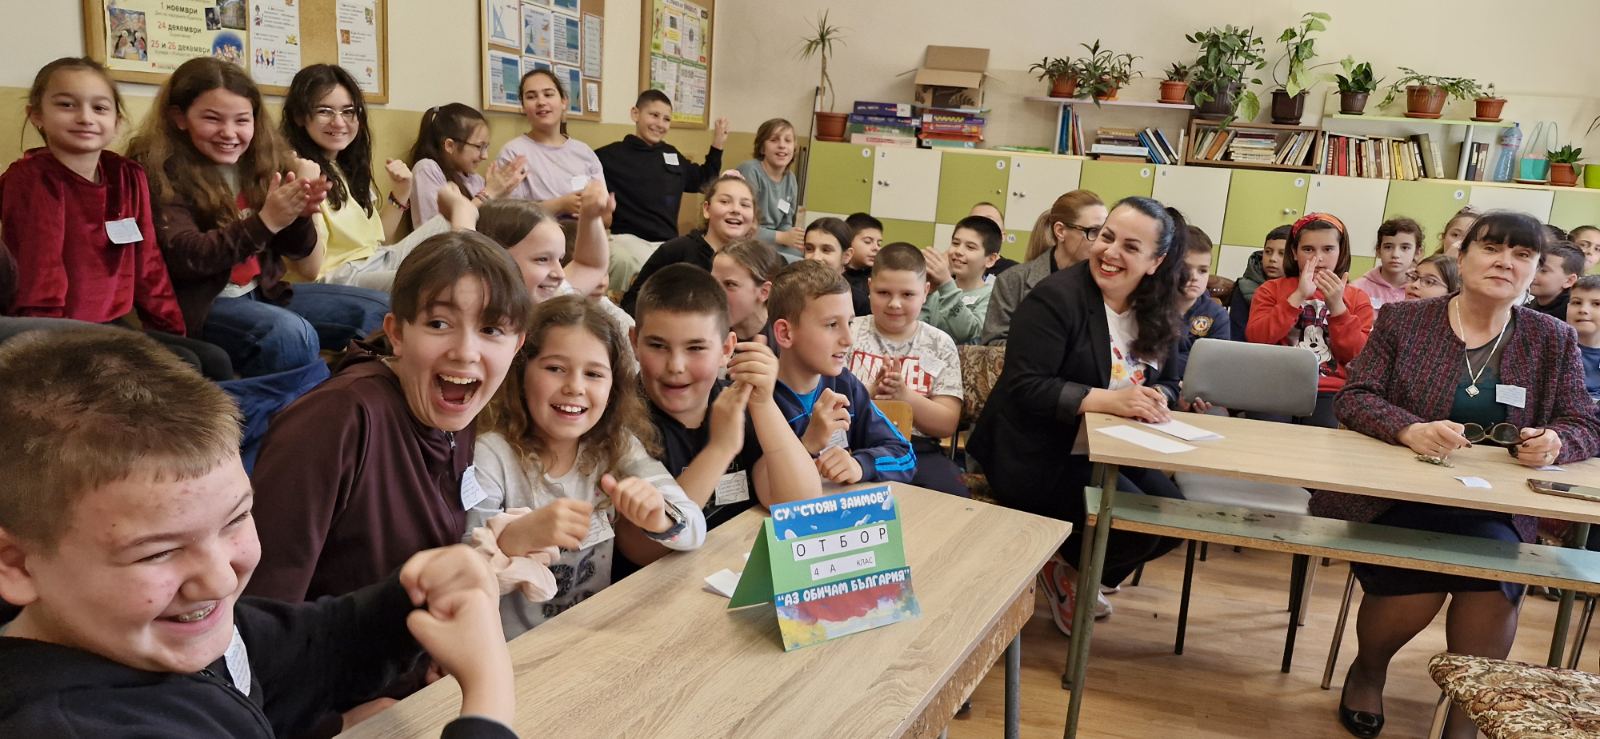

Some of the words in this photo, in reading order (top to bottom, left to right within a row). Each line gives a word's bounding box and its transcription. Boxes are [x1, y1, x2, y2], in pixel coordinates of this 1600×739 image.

[166, 4, 198, 14] ноември
[168, 24, 202, 33] декември
[151, 40, 160, 48] 25
[178, 44, 211, 54] декември
[774, 508, 791, 521] СУ
[814, 567, 820, 576] 4
[856, 557, 874, 566] КЛАС
[803, 581, 848, 603] ОБИЧАМ
